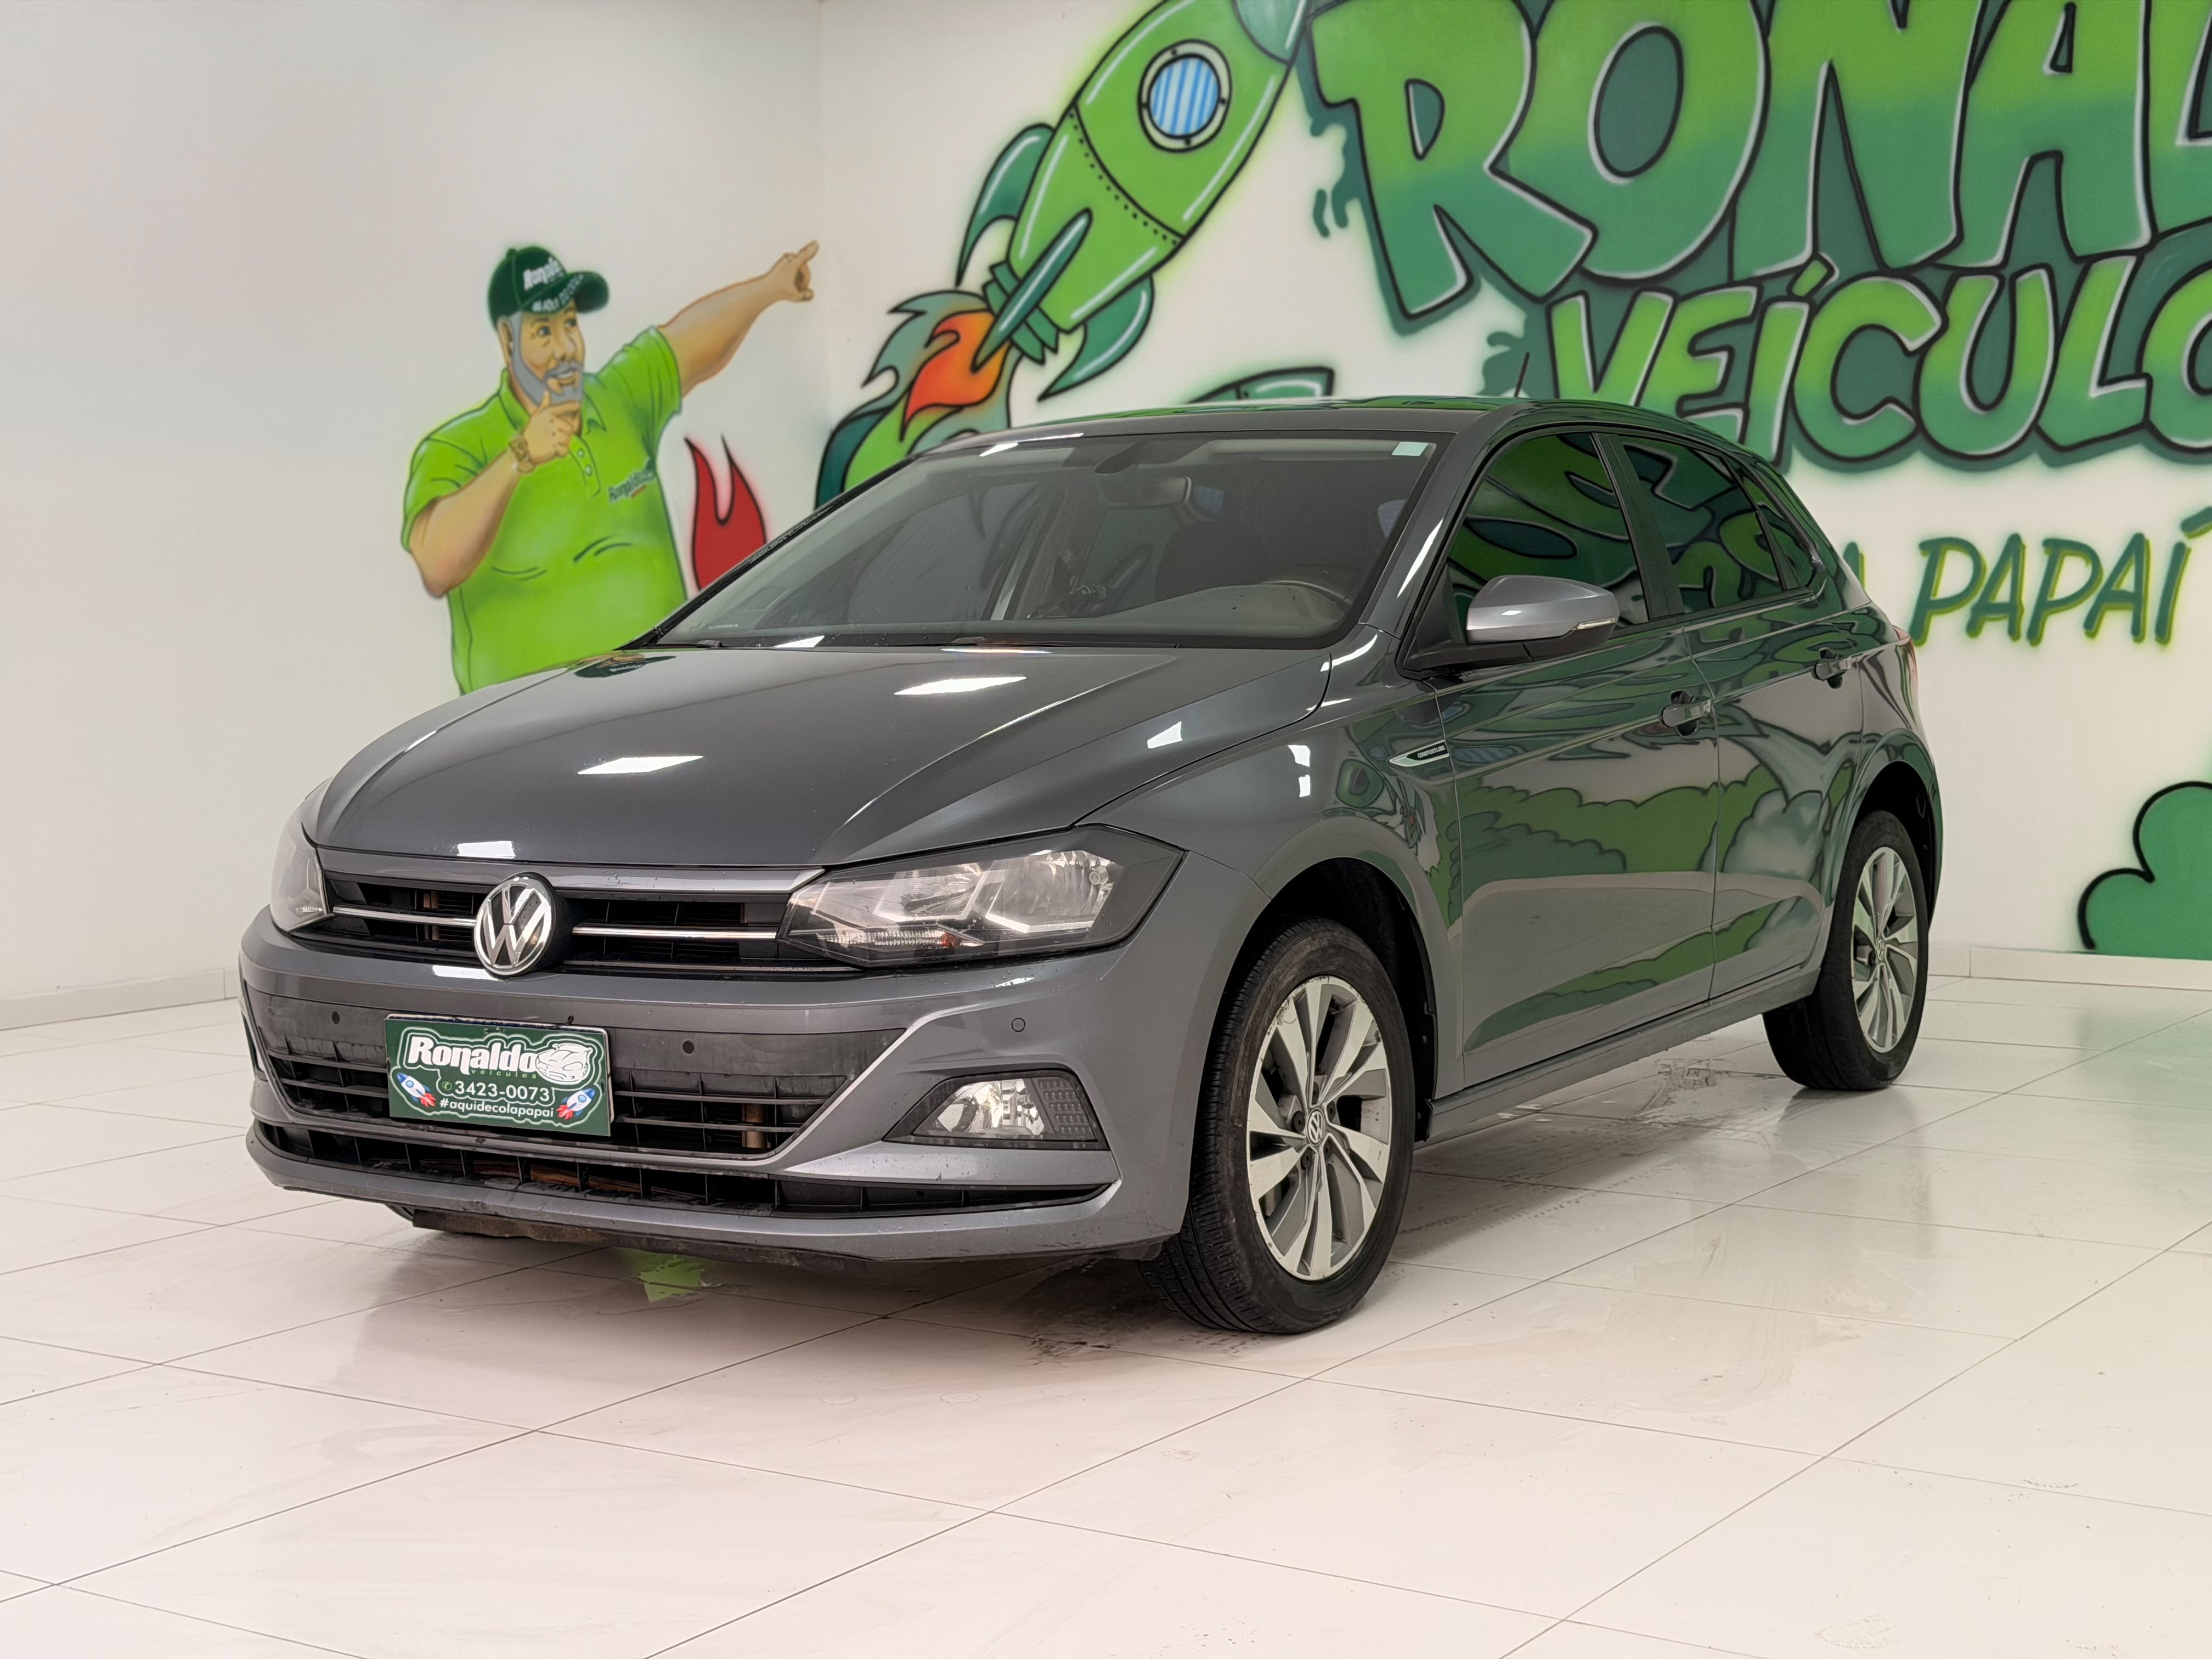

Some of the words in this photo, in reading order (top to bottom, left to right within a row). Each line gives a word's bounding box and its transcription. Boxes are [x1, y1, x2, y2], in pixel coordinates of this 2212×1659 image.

[1908, 506, 2212, 646] PAPAÍ
[478, 879, 549, 970] VW
[408, 1036, 537, 1075] Ronaldo
[439, 1097, 554, 1119] #aquidecolapapai
[454, 1080, 550, 1102] 3423-0073
